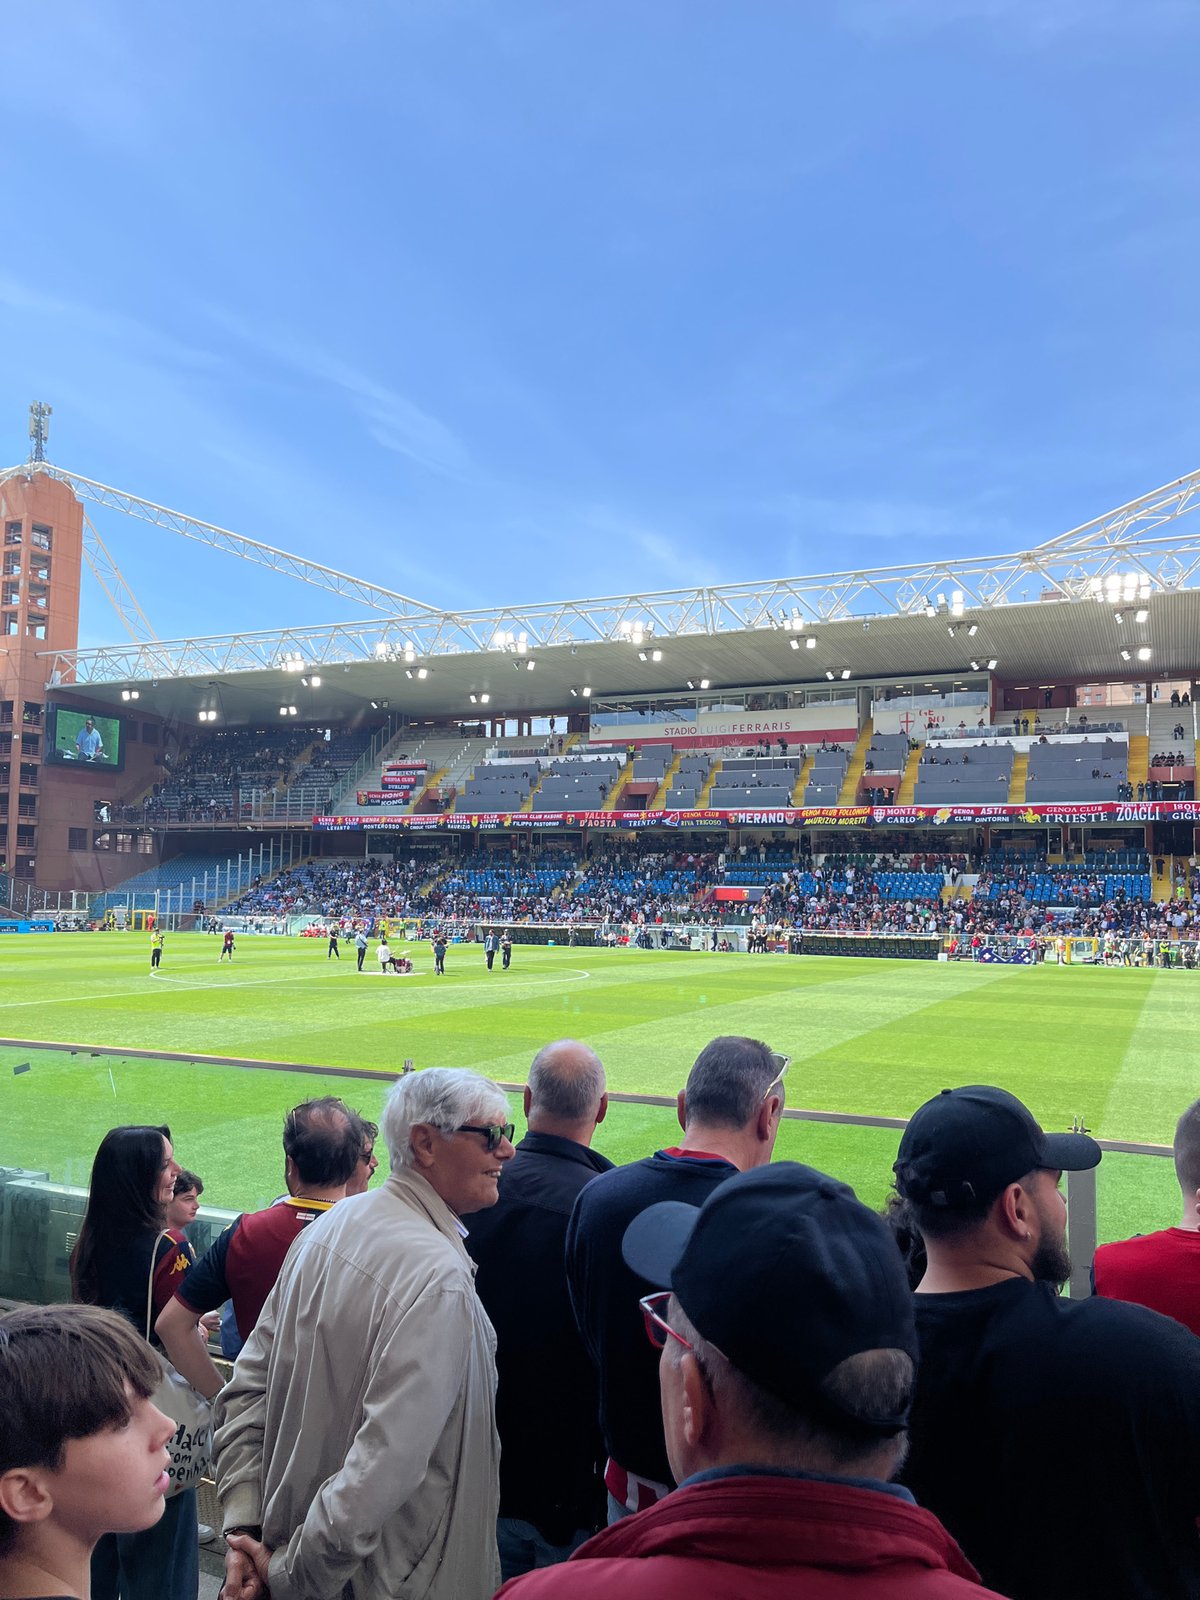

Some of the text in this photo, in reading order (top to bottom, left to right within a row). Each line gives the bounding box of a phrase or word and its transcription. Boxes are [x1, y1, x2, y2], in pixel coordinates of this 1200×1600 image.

[664, 726, 697, 736] STADIO
[801, 809, 820, 817] GENOA
[838, 807, 871, 816] FOLLONICA
[1116, 806, 1160, 822] ZOAGLI
[738, 812, 784, 824] MERANO
[803, 816, 868, 825] MAURIZIO MORETTI
[1042, 812, 1108, 823] TRIESTE
